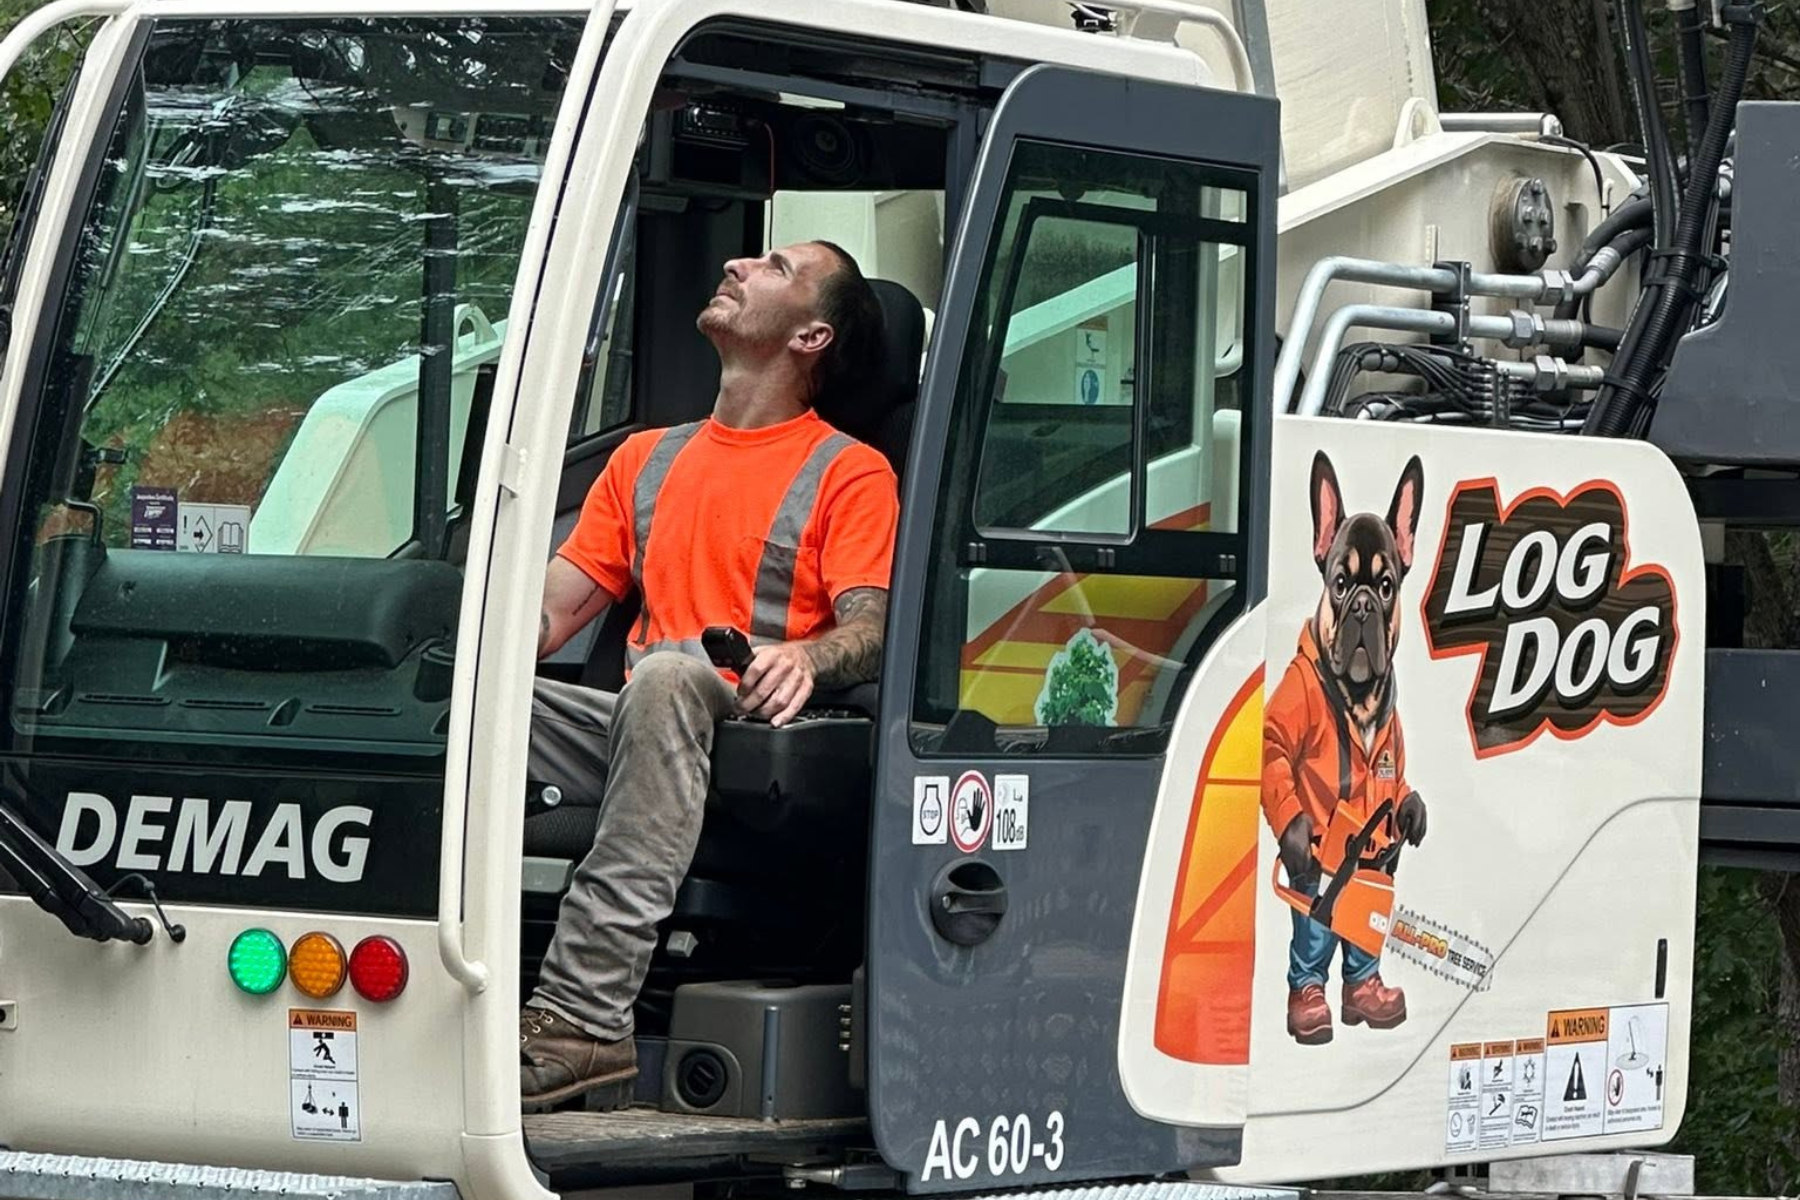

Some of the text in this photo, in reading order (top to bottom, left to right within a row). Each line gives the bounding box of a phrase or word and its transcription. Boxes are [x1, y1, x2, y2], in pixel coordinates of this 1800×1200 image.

[1444, 522, 1611, 614] LOG
[1488, 606, 1661, 714] DOG
[56, 791, 374, 883] DEMAG
[922, 809, 939, 820] STOP
[996, 808, 1016, 843] 108
[306, 1013, 352, 1028] WARNING
[1563, 1015, 1605, 1037] WARNING
[921, 1110, 1064, 1182] AC 60-3
